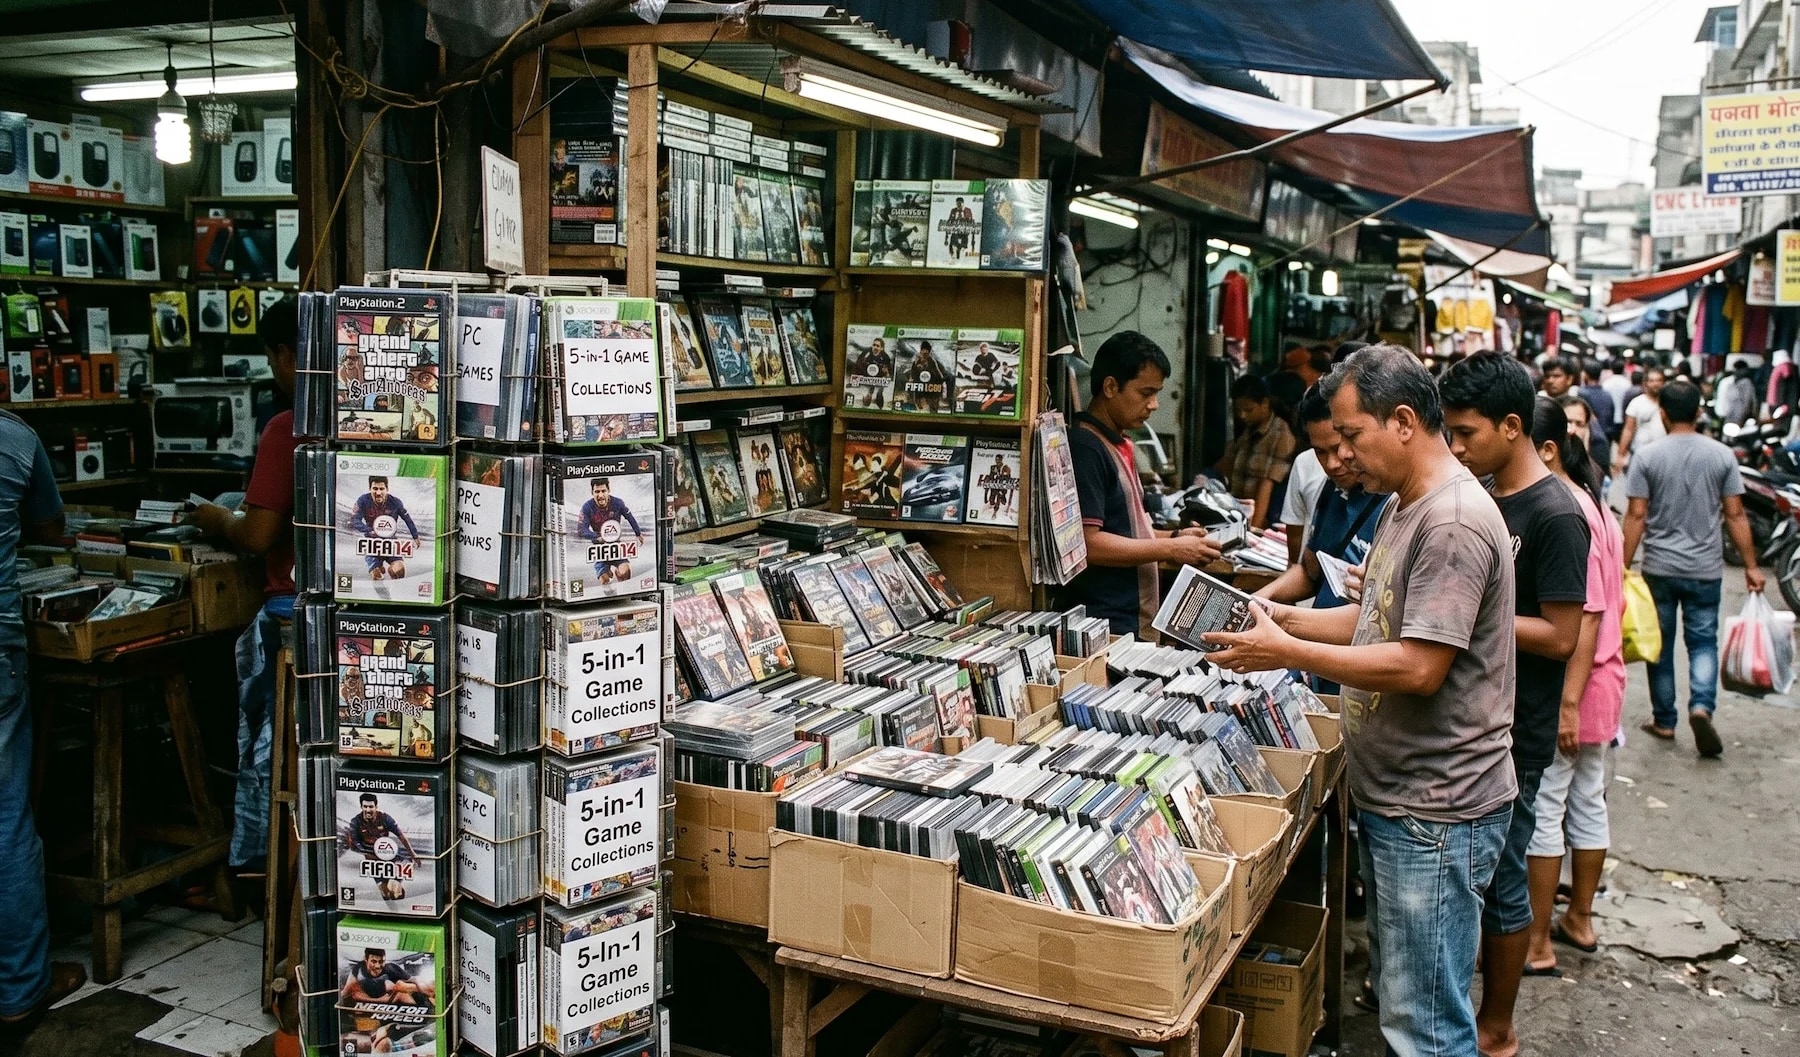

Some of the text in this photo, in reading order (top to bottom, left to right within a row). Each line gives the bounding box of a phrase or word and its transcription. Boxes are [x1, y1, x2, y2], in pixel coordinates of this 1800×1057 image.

[359, 332, 410, 353] grand
[463, 324, 481, 345] PC
[366, 349, 418, 367] theft
[614, 350, 649, 365] GAME
[364, 366, 406, 381] auto
[378, 520, 392, 528] EA
[358, 539, 413, 556] FIFA 14
[588, 542, 637, 560] FIFA 14
[360, 654, 406, 672] grand
[582, 643, 644, 674] 5-in-1
[367, 669, 413, 686] theft
[365, 685, 403, 699] auto
[586, 677, 643, 699] Game
[571, 699, 656, 724] Collections
[473, 800, 487, 817] PC
[581, 787, 643, 822] 5-in-1
[585, 820, 641, 846] Game
[378, 842, 394, 850] EA
[571, 841, 654, 872] Collections
[361, 862, 412, 878] FIFA 14
[577, 930, 641, 969] 5-In-1
[468, 961, 491, 982] Game
[581, 963, 638, 992] Game
[567, 982, 650, 1018] Collections
